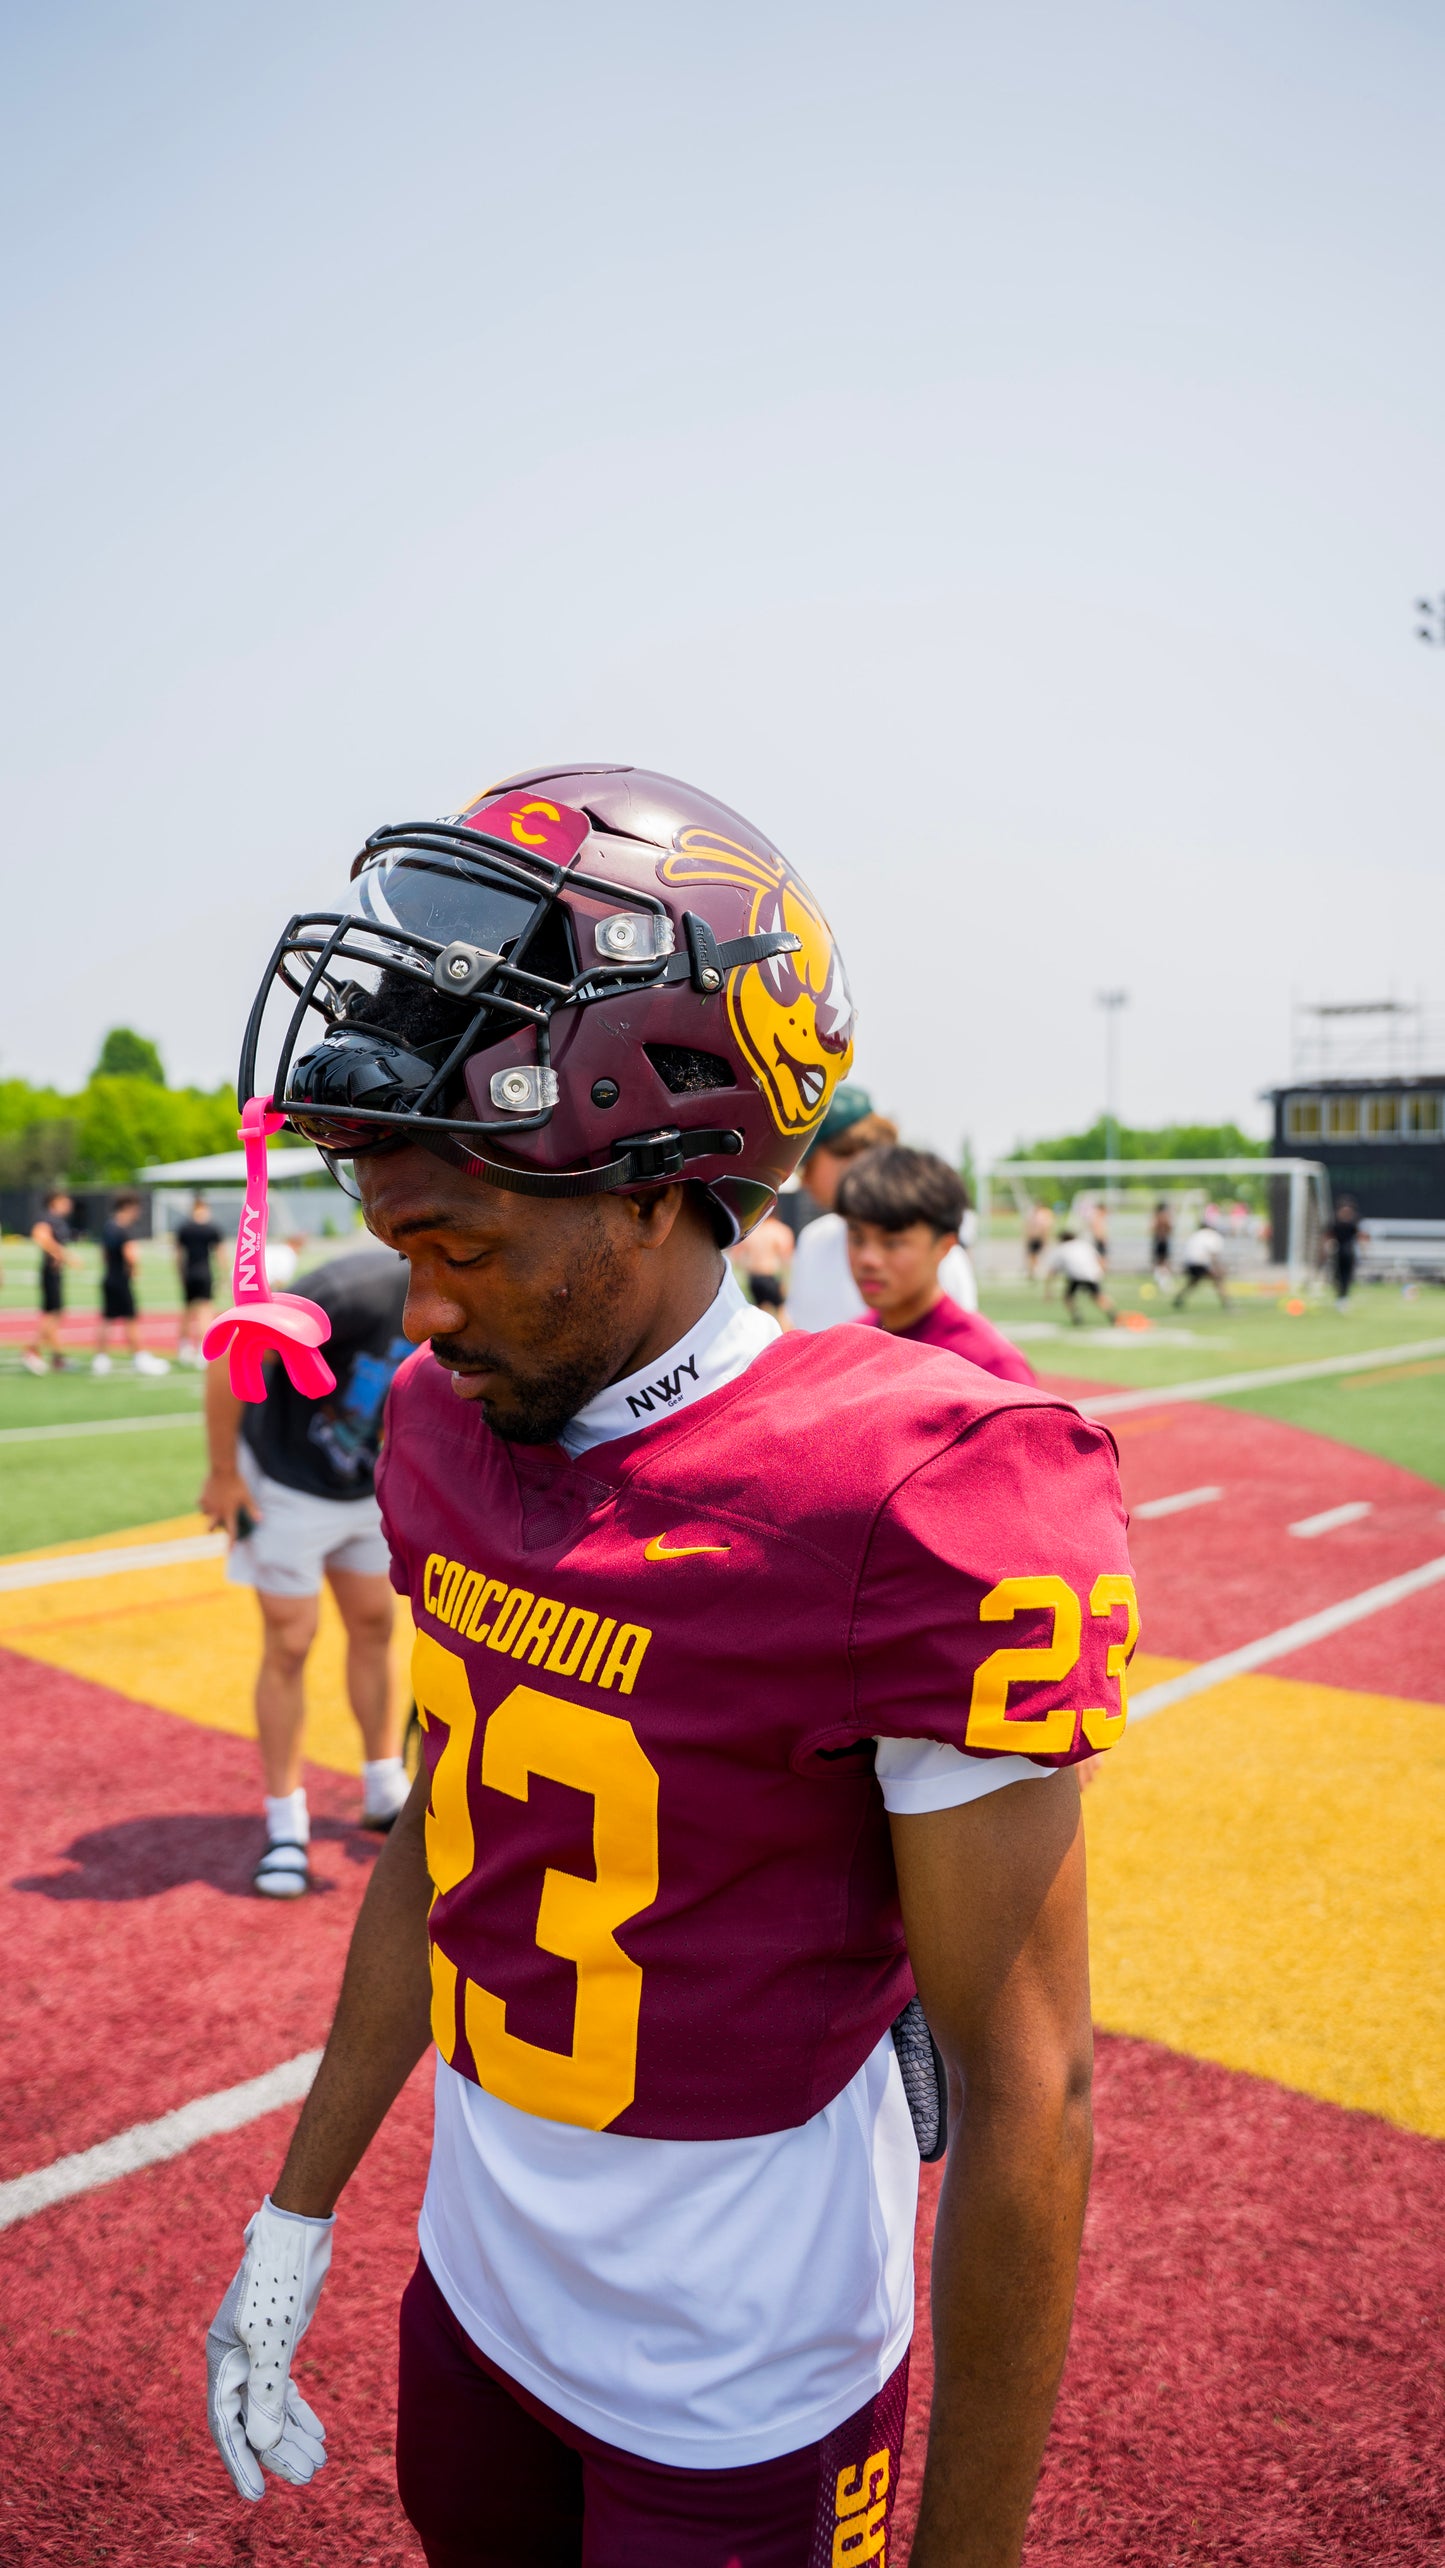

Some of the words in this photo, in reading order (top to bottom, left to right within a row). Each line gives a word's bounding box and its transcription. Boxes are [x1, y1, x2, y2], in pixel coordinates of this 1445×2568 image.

[238, 1203, 260, 1291] NWY
[625, 1353, 700, 1418] NWY
[667, 1394, 684, 1407] Gear
[423, 1553, 652, 1694] CONCORDIA
[965, 1574, 1140, 1753] 23
[832, 2447, 890, 2568] RS
